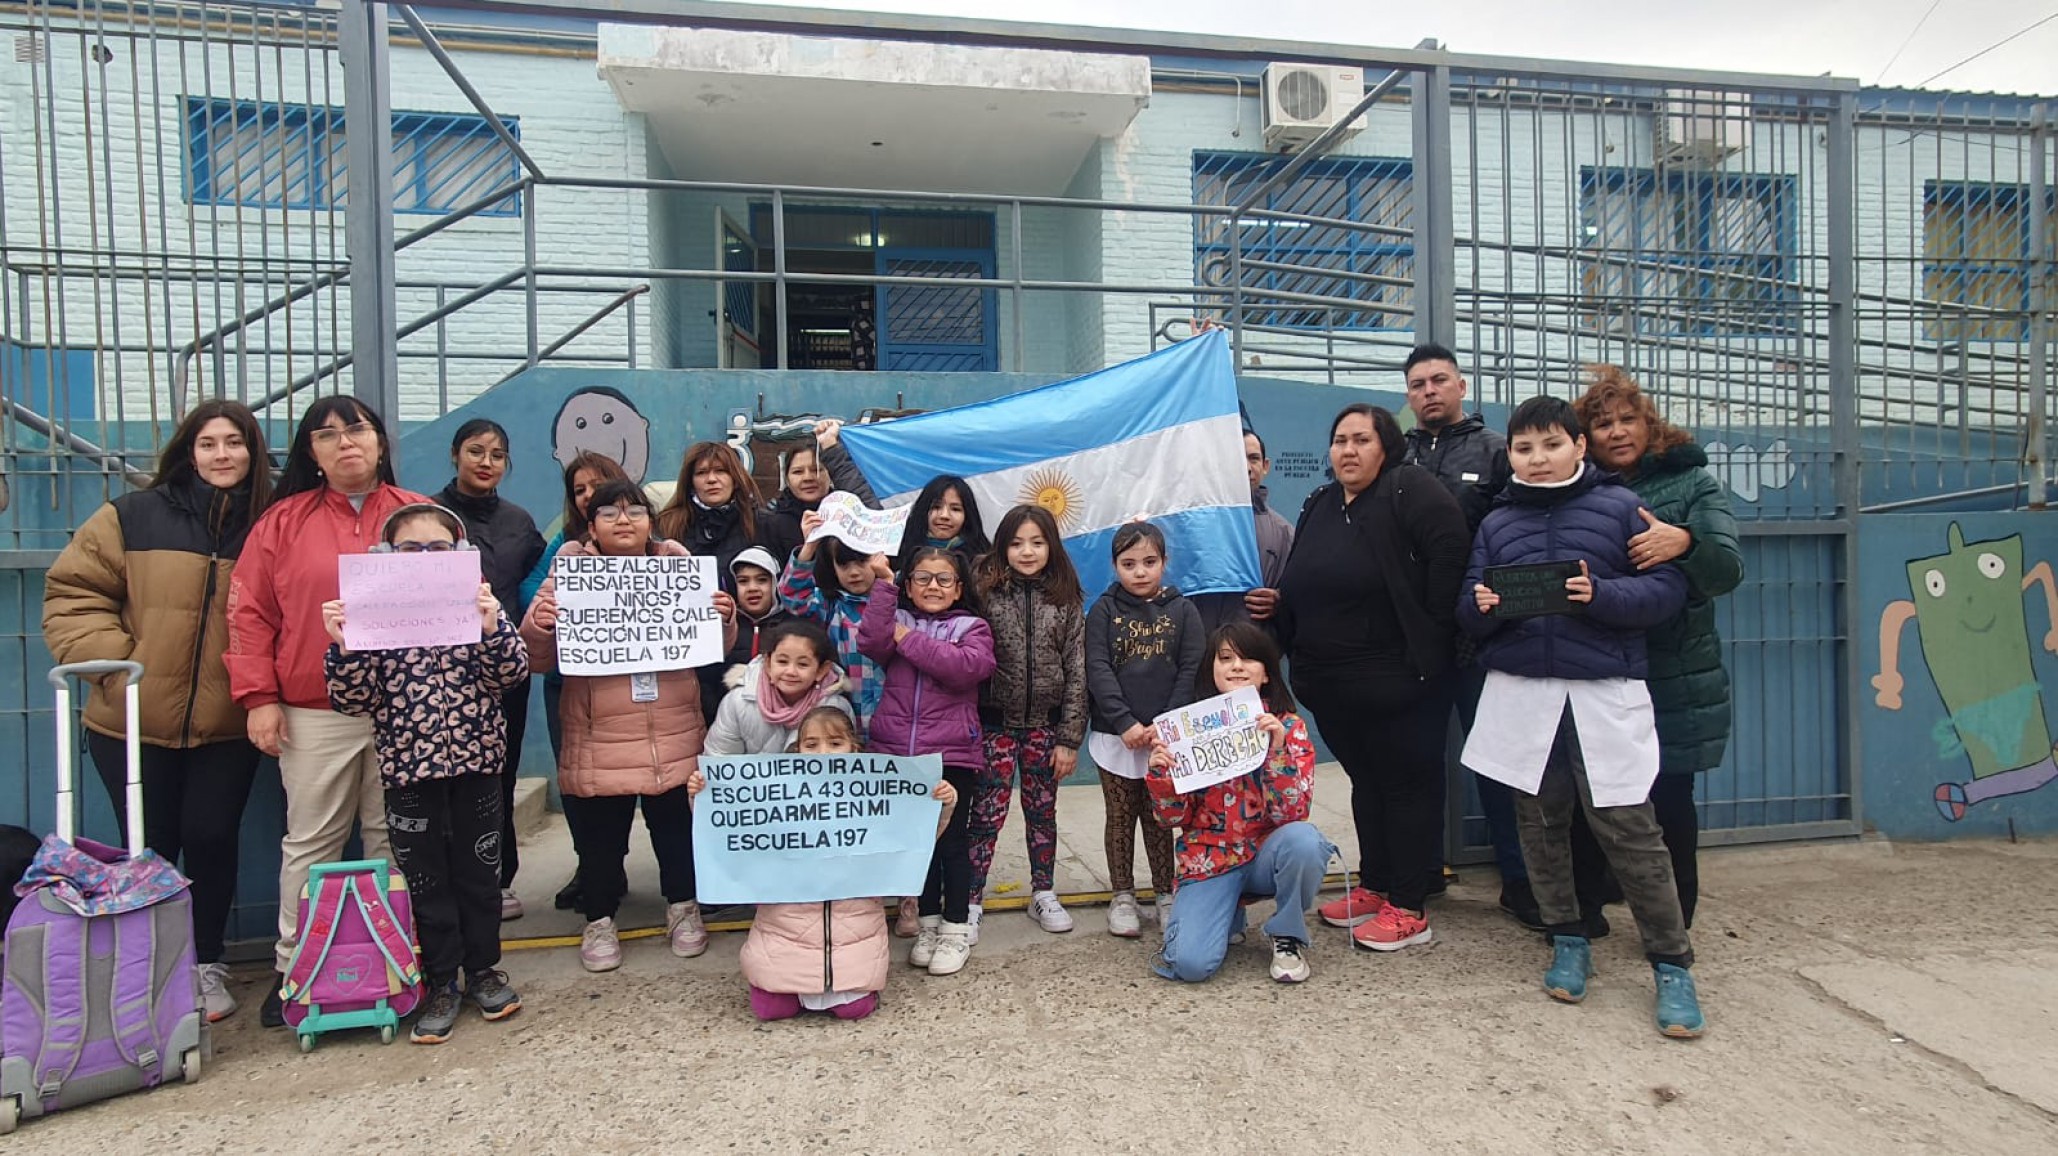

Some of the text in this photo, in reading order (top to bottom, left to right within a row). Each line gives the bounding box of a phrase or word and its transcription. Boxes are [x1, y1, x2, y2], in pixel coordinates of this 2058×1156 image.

[554, 557, 700, 574] PUEDE ALGUIEN
[667, 575, 701, 591] LOS
[556, 607, 718, 627] QUEREMOS CALE
[645, 626, 672, 642] EN
[678, 625, 697, 641] MI
[559, 645, 690, 665] ESCUELA 197
[1192, 725, 1269, 772] DERECHO
[706, 757, 898, 781] NO QUIERO IR A LA
[711, 779, 928, 804] ESCUELA 43 QUIERO
[710, 799, 890, 827] QUEDARME EN MI
[727, 828, 868, 852] ESCUELA 197
